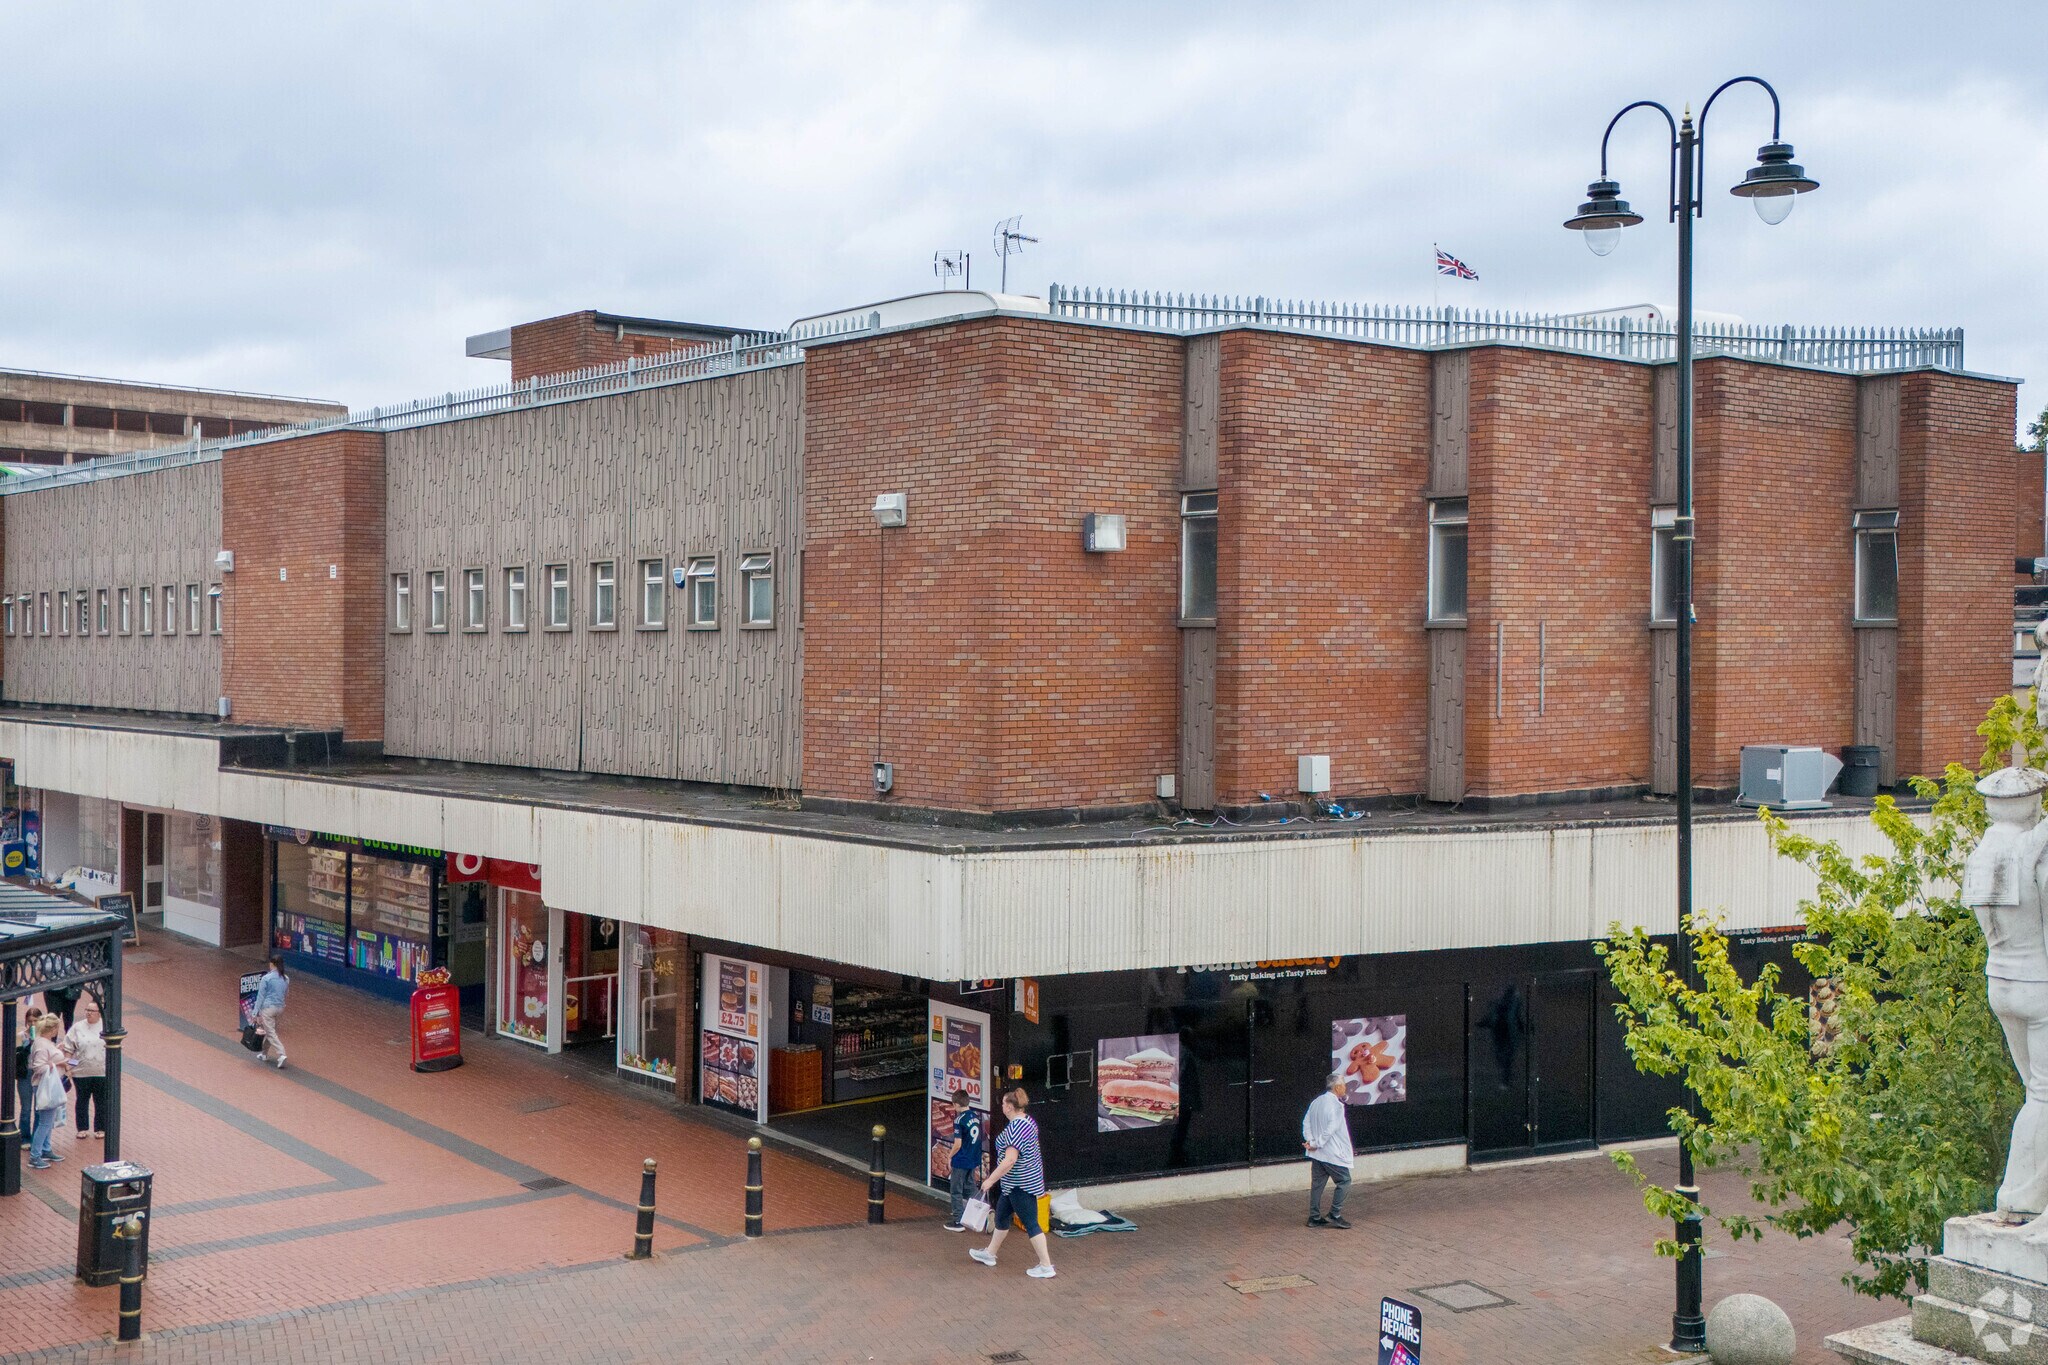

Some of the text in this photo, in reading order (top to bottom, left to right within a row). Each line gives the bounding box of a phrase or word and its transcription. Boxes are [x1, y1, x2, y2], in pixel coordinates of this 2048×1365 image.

[1740, 937, 1756, 945] Tasty
[1756, 935, 1777, 944] Baking
[1784, 934, 1801, 943] Tasty
[1229, 973, 1248, 982] Tasty
[1250, 971, 1275, 981] Baking
[1285, 969, 1304, 978] Tasty
[1306, 968, 1327, 976] Prices
[721, 1012, 744, 1026] £2.75
[970, 1126, 980, 1144] 9
[1383, 1301, 1413, 1326] PHONE
[1382, 1316, 1420, 1344] REPAIRS
